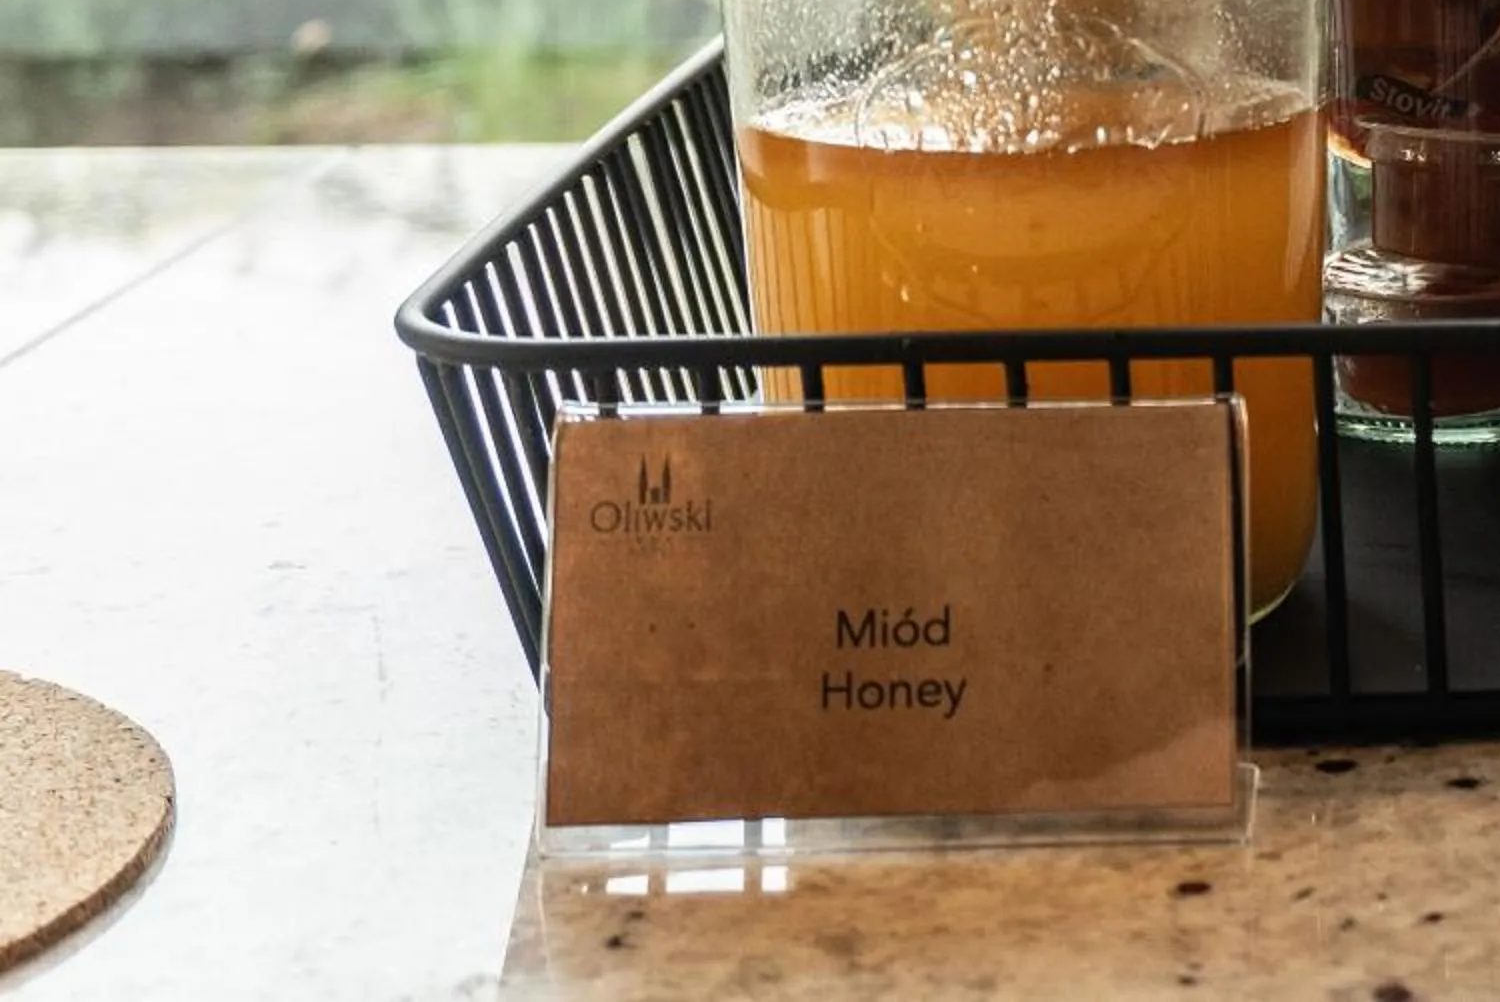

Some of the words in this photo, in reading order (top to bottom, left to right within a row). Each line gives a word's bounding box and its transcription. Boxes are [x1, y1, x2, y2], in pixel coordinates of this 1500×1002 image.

[590, 498, 712, 533] Oliwski
[837, 604, 950, 649] Miód
[822, 671, 967, 719] Honey
